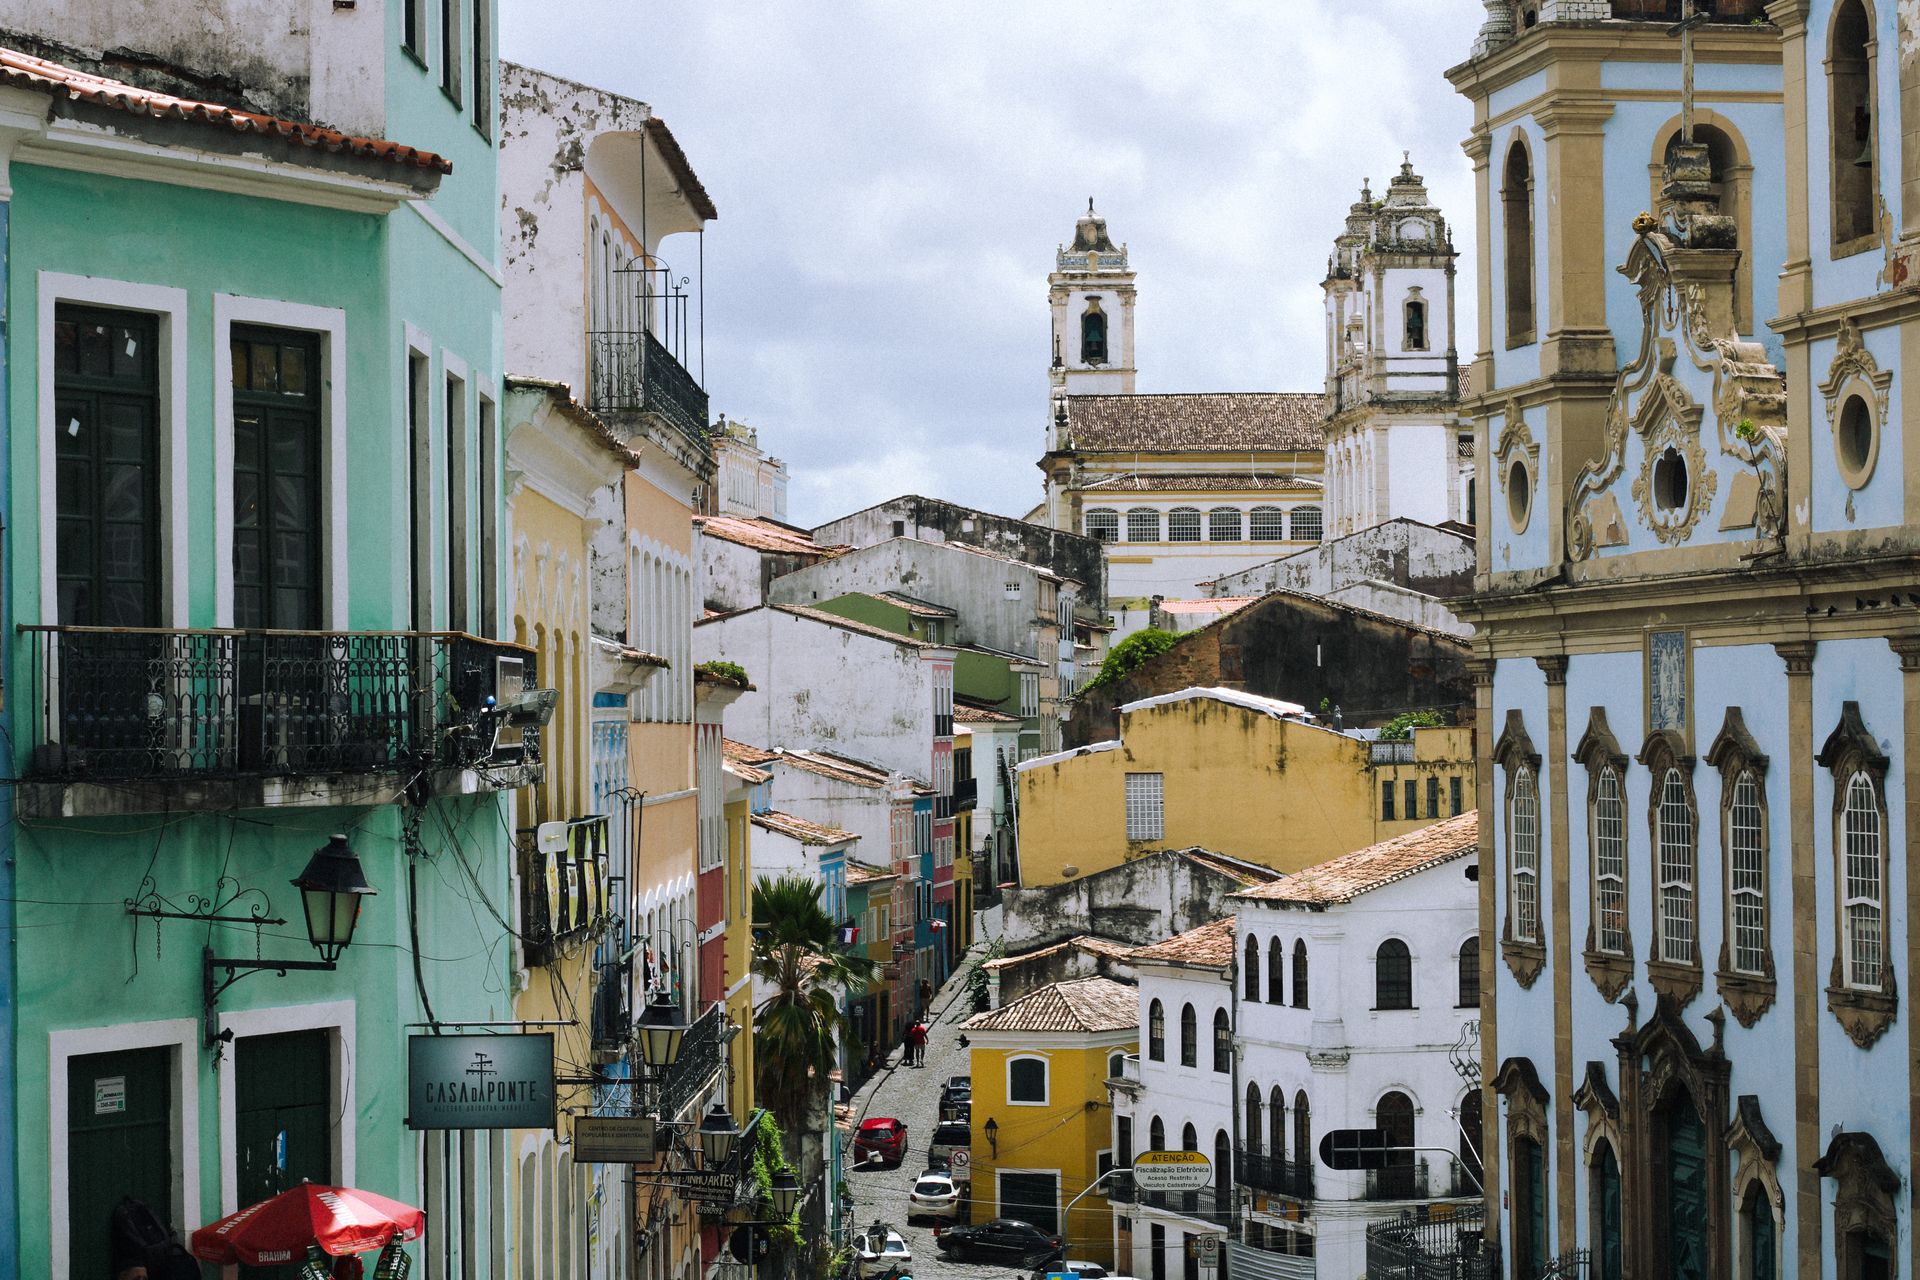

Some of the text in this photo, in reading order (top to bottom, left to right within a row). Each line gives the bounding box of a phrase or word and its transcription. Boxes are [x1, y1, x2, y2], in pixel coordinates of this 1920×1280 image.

[426, 1081, 537, 1103] CASA DA PONTE
[1136, 1166, 1175, 1174] Fiscalização
[258, 1250, 291, 1262] BRAHMA
